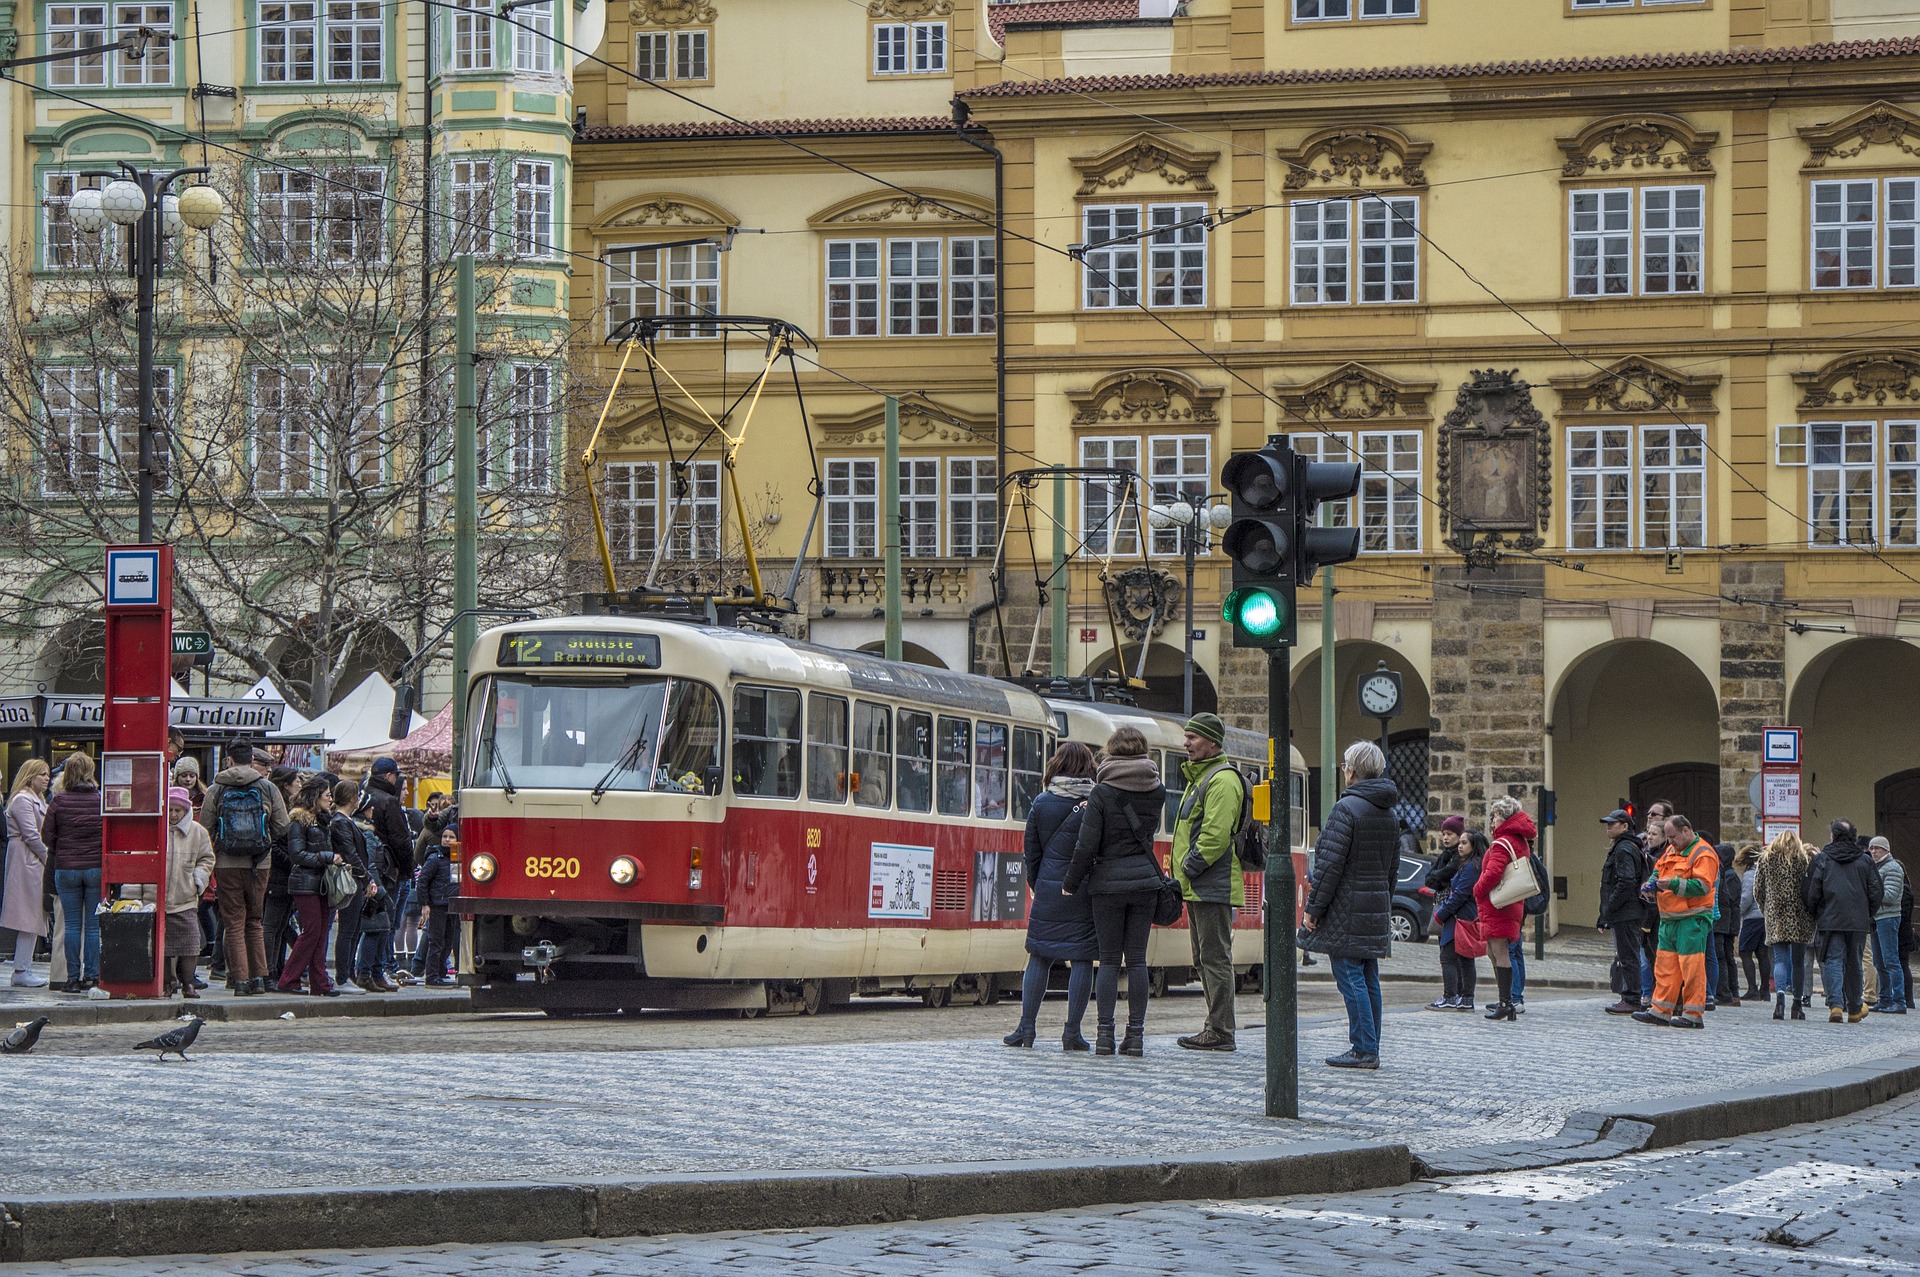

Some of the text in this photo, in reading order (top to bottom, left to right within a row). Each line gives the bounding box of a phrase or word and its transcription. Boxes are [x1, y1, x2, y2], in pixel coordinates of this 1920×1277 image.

[175, 636, 193, 651] WC
[510, 635, 542, 662] 12
[554, 651, 646, 663] Barrandov
[170, 704, 277, 727] Trdelník
[806, 827, 821, 848] 8520
[525, 856, 580, 879] 8520
